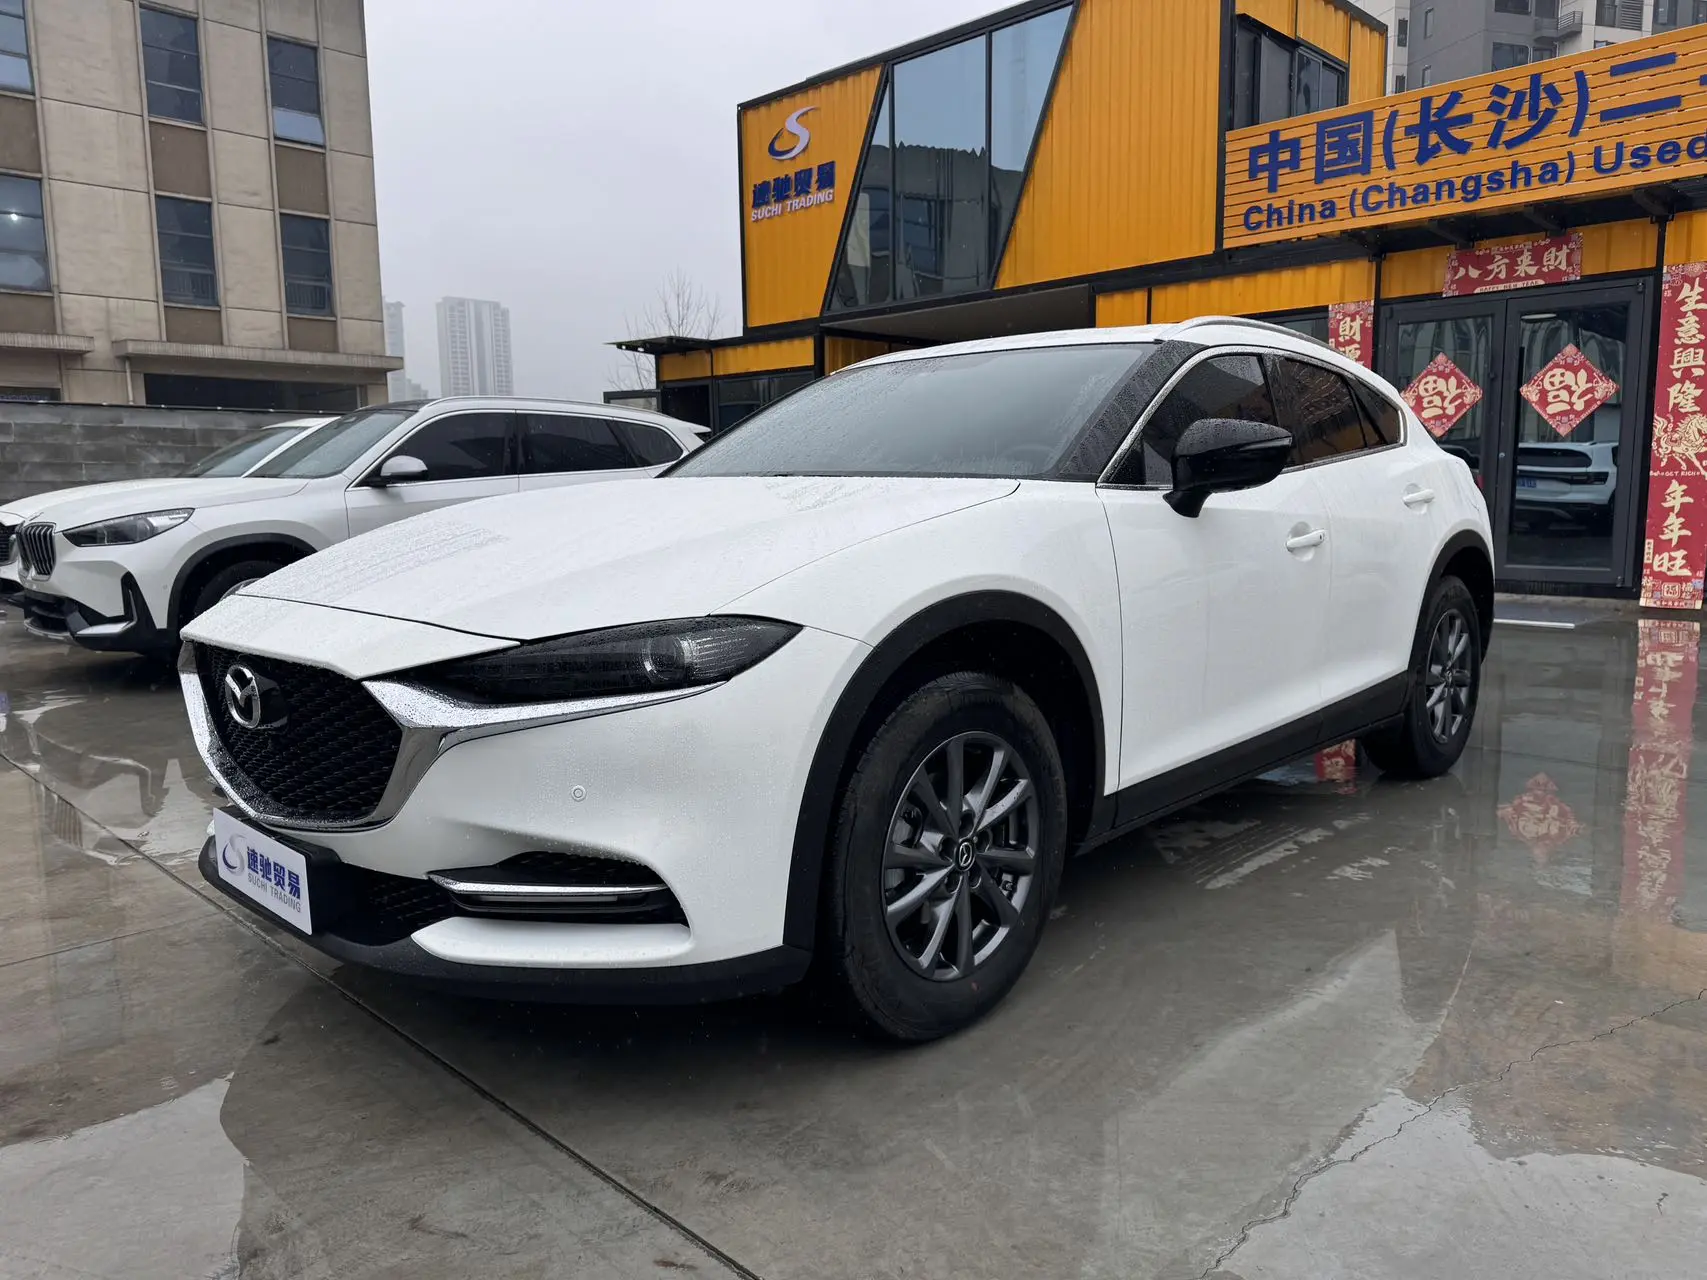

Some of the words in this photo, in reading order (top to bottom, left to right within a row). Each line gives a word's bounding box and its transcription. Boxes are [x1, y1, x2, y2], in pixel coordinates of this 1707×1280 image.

[1248, 52, 1707, 194] 中国(长沙)二
[752, 204, 782, 222] SUCHI
[787, 189, 834, 212] TRADING
[1244, 200, 1337, 231] China
[1350, 151, 1575, 218] (Changsha)
[1593, 128, 1707, 175] Used
[1653, 479, 1693, 576] 年年旺
[247, 846, 301, 900] 速驰贸易
[248, 873, 268, 893] SUCHI
[270, 886, 301, 913] TRADING
